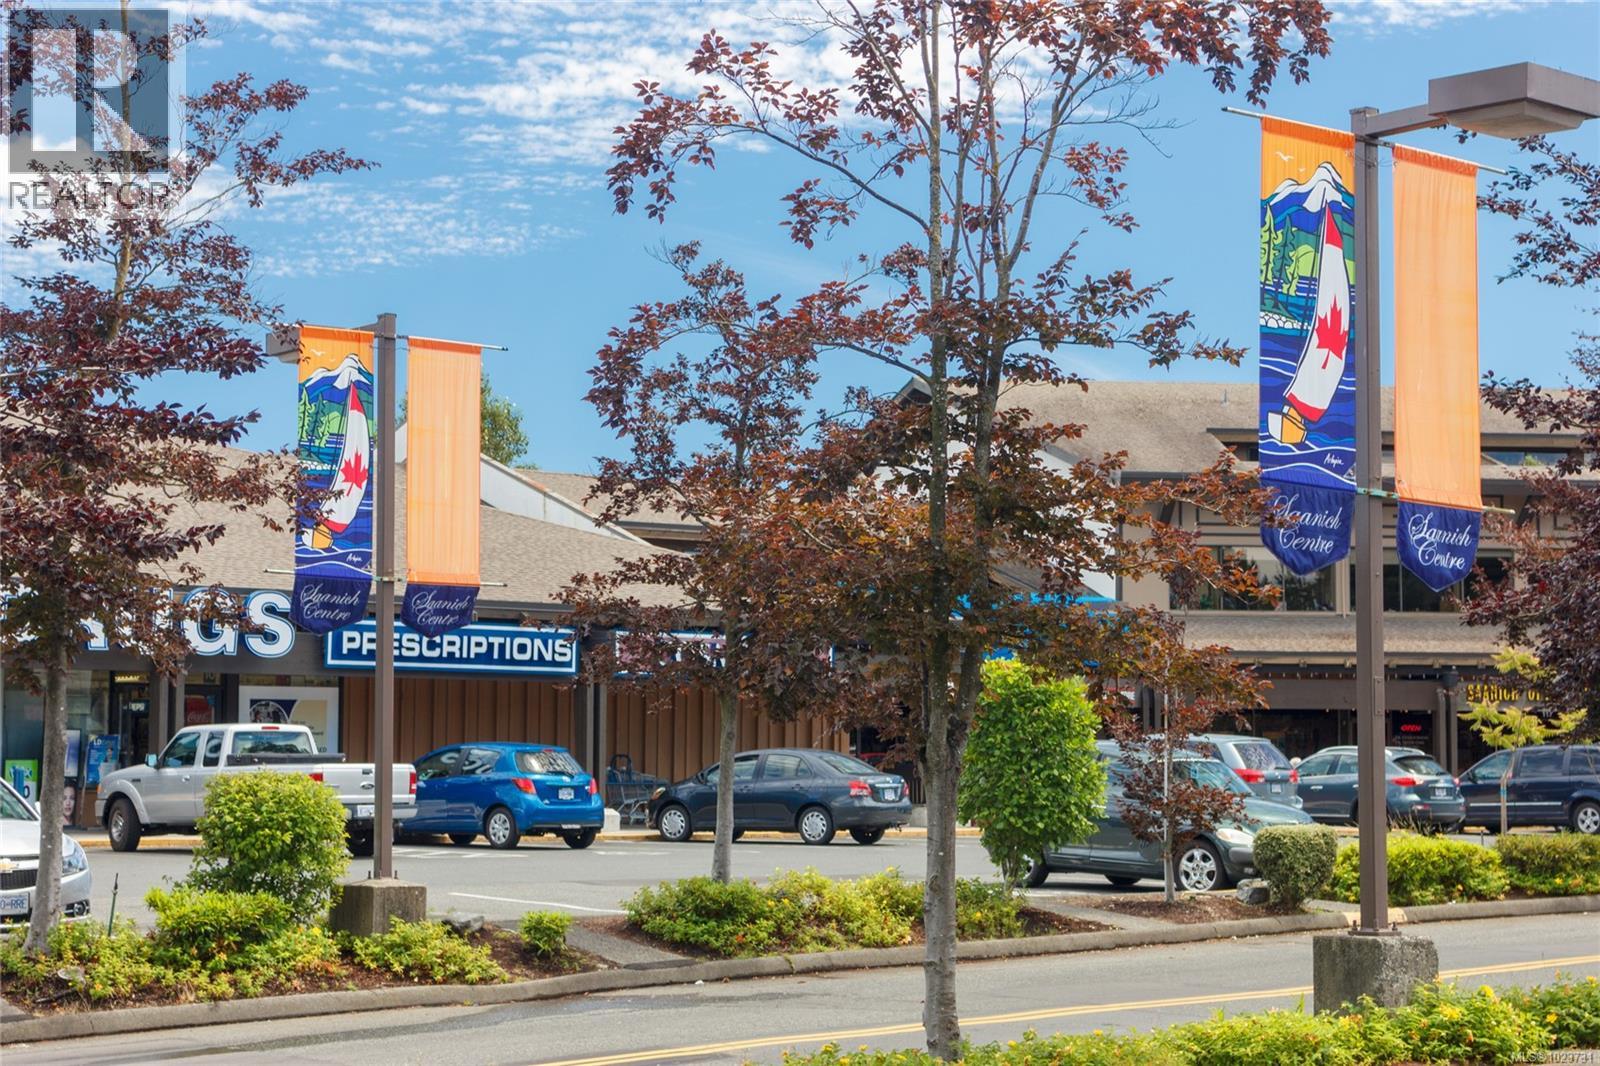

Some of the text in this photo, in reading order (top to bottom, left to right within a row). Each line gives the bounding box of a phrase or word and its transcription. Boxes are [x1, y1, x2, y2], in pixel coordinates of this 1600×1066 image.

[1272, 493, 1343, 531] Saanich
[1279, 524, 1335, 554] Centre
[1408, 512, 1472, 548] Saanich
[1418, 540, 1466, 570] Centre
[301, 583, 361, 606] Saanich
[411, 590, 471, 611] Saanich
[304, 602, 351, 620] Centre
[416, 608, 460, 626] Centre
